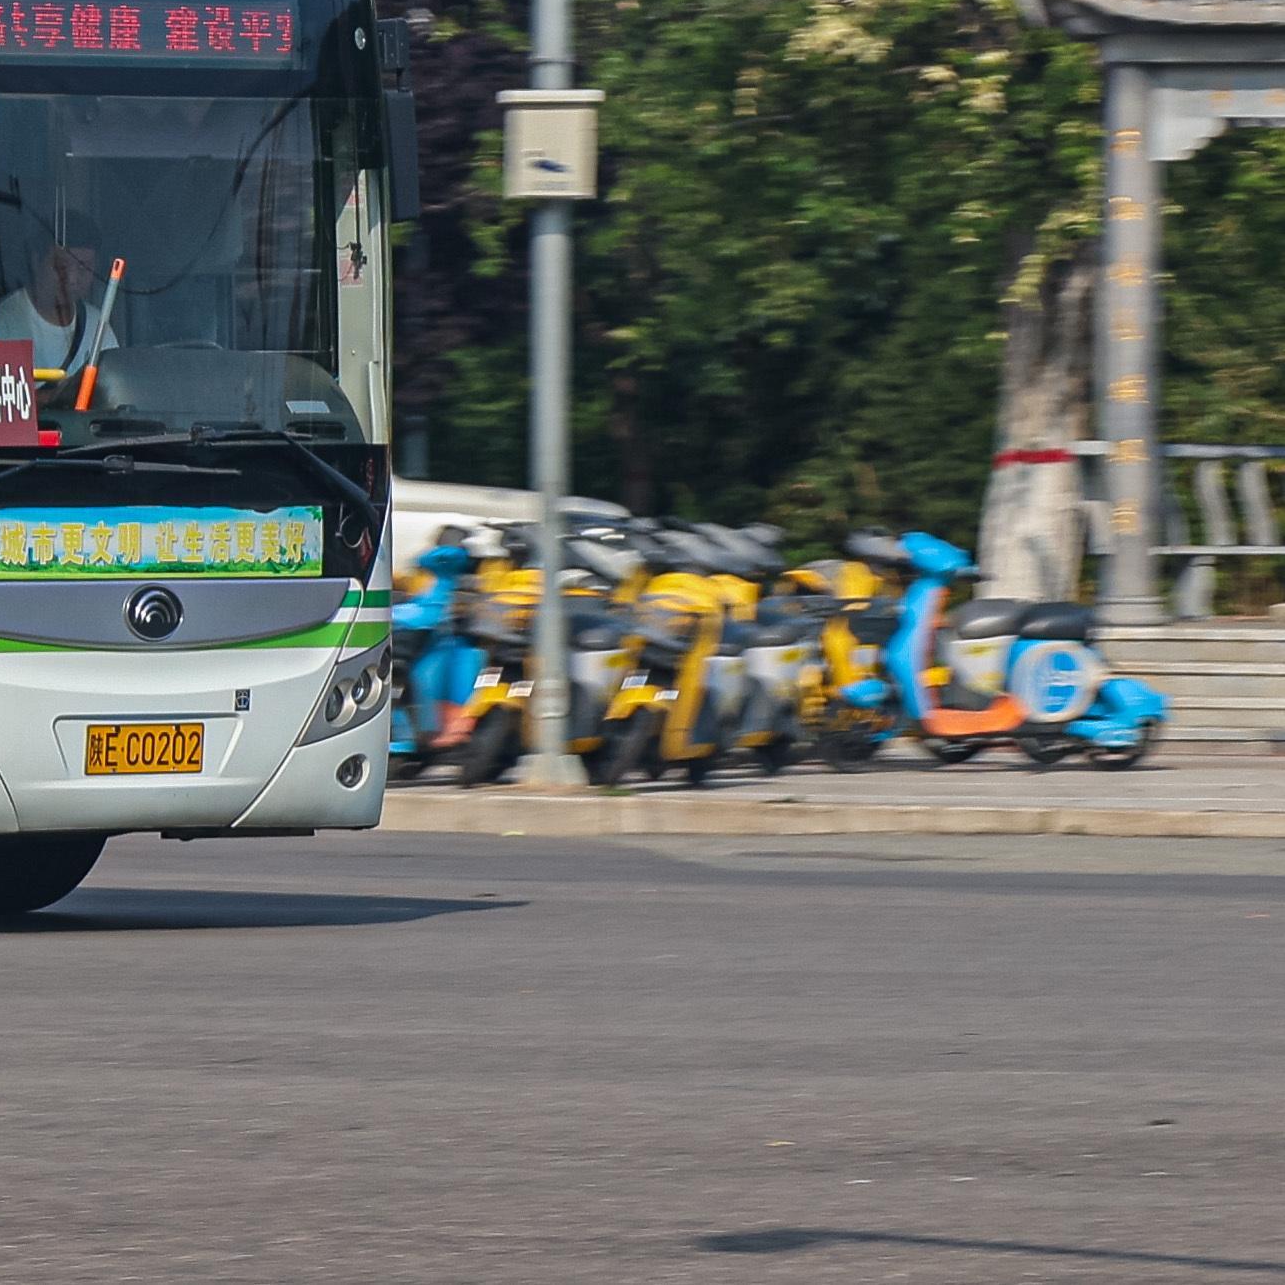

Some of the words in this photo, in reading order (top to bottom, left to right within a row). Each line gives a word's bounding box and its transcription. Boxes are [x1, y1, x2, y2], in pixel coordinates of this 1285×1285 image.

[154, 519, 306, 565] 让生活更美好
